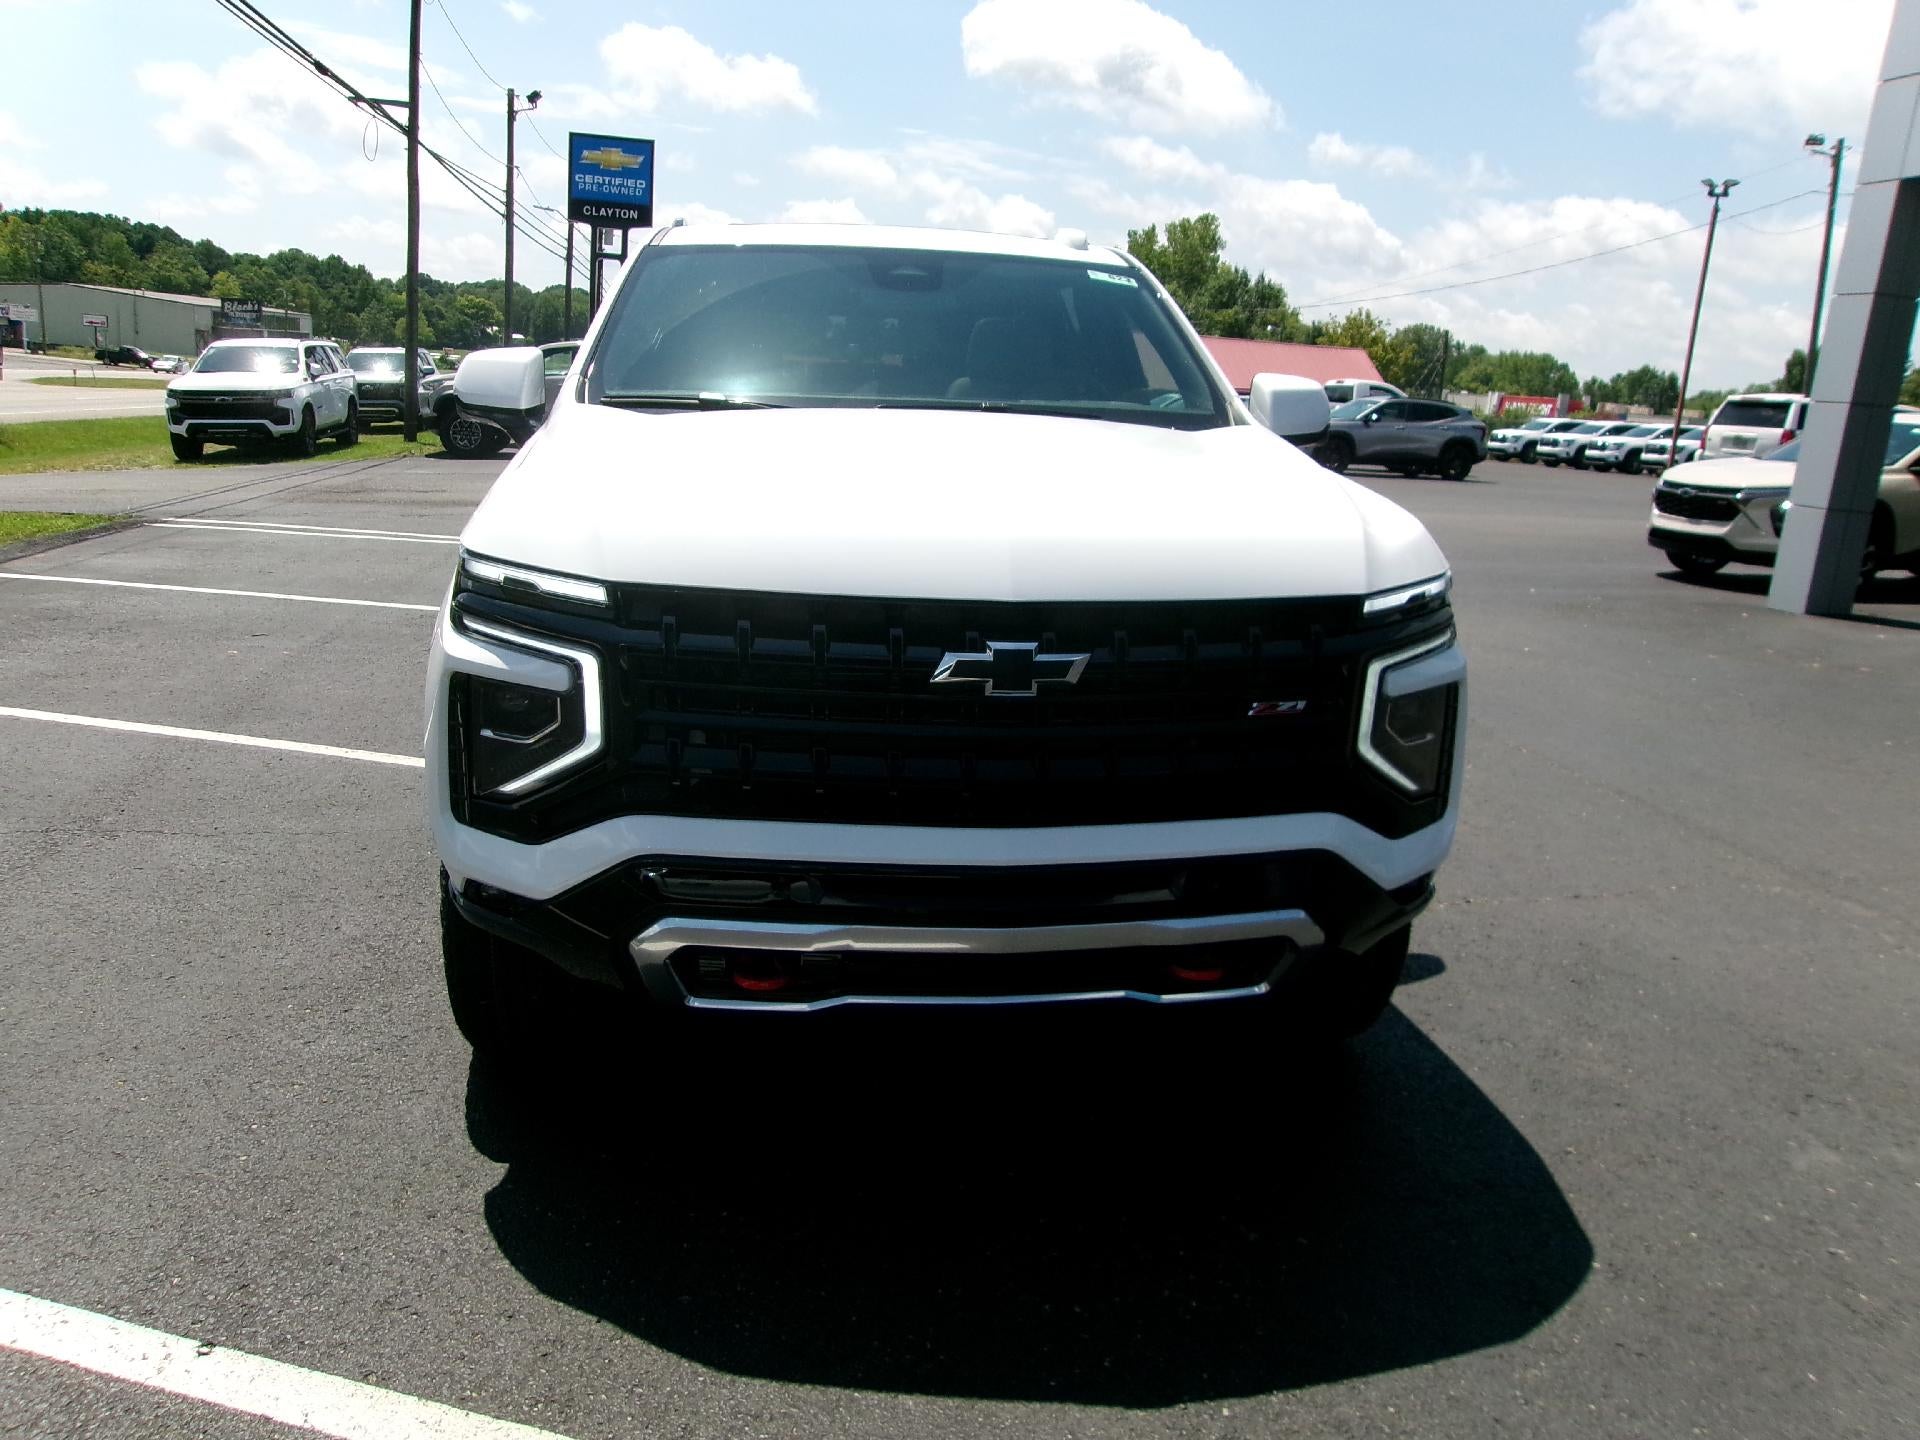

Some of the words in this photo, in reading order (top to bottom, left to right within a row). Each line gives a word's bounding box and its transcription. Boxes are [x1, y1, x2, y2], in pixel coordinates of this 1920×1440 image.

[575, 174, 646, 188] CERTIFIED
[579, 183, 643, 196] PRE-OWNED
[583, 205, 638, 220] CLAYTON
[1247, 700, 1307, 716] Z71
